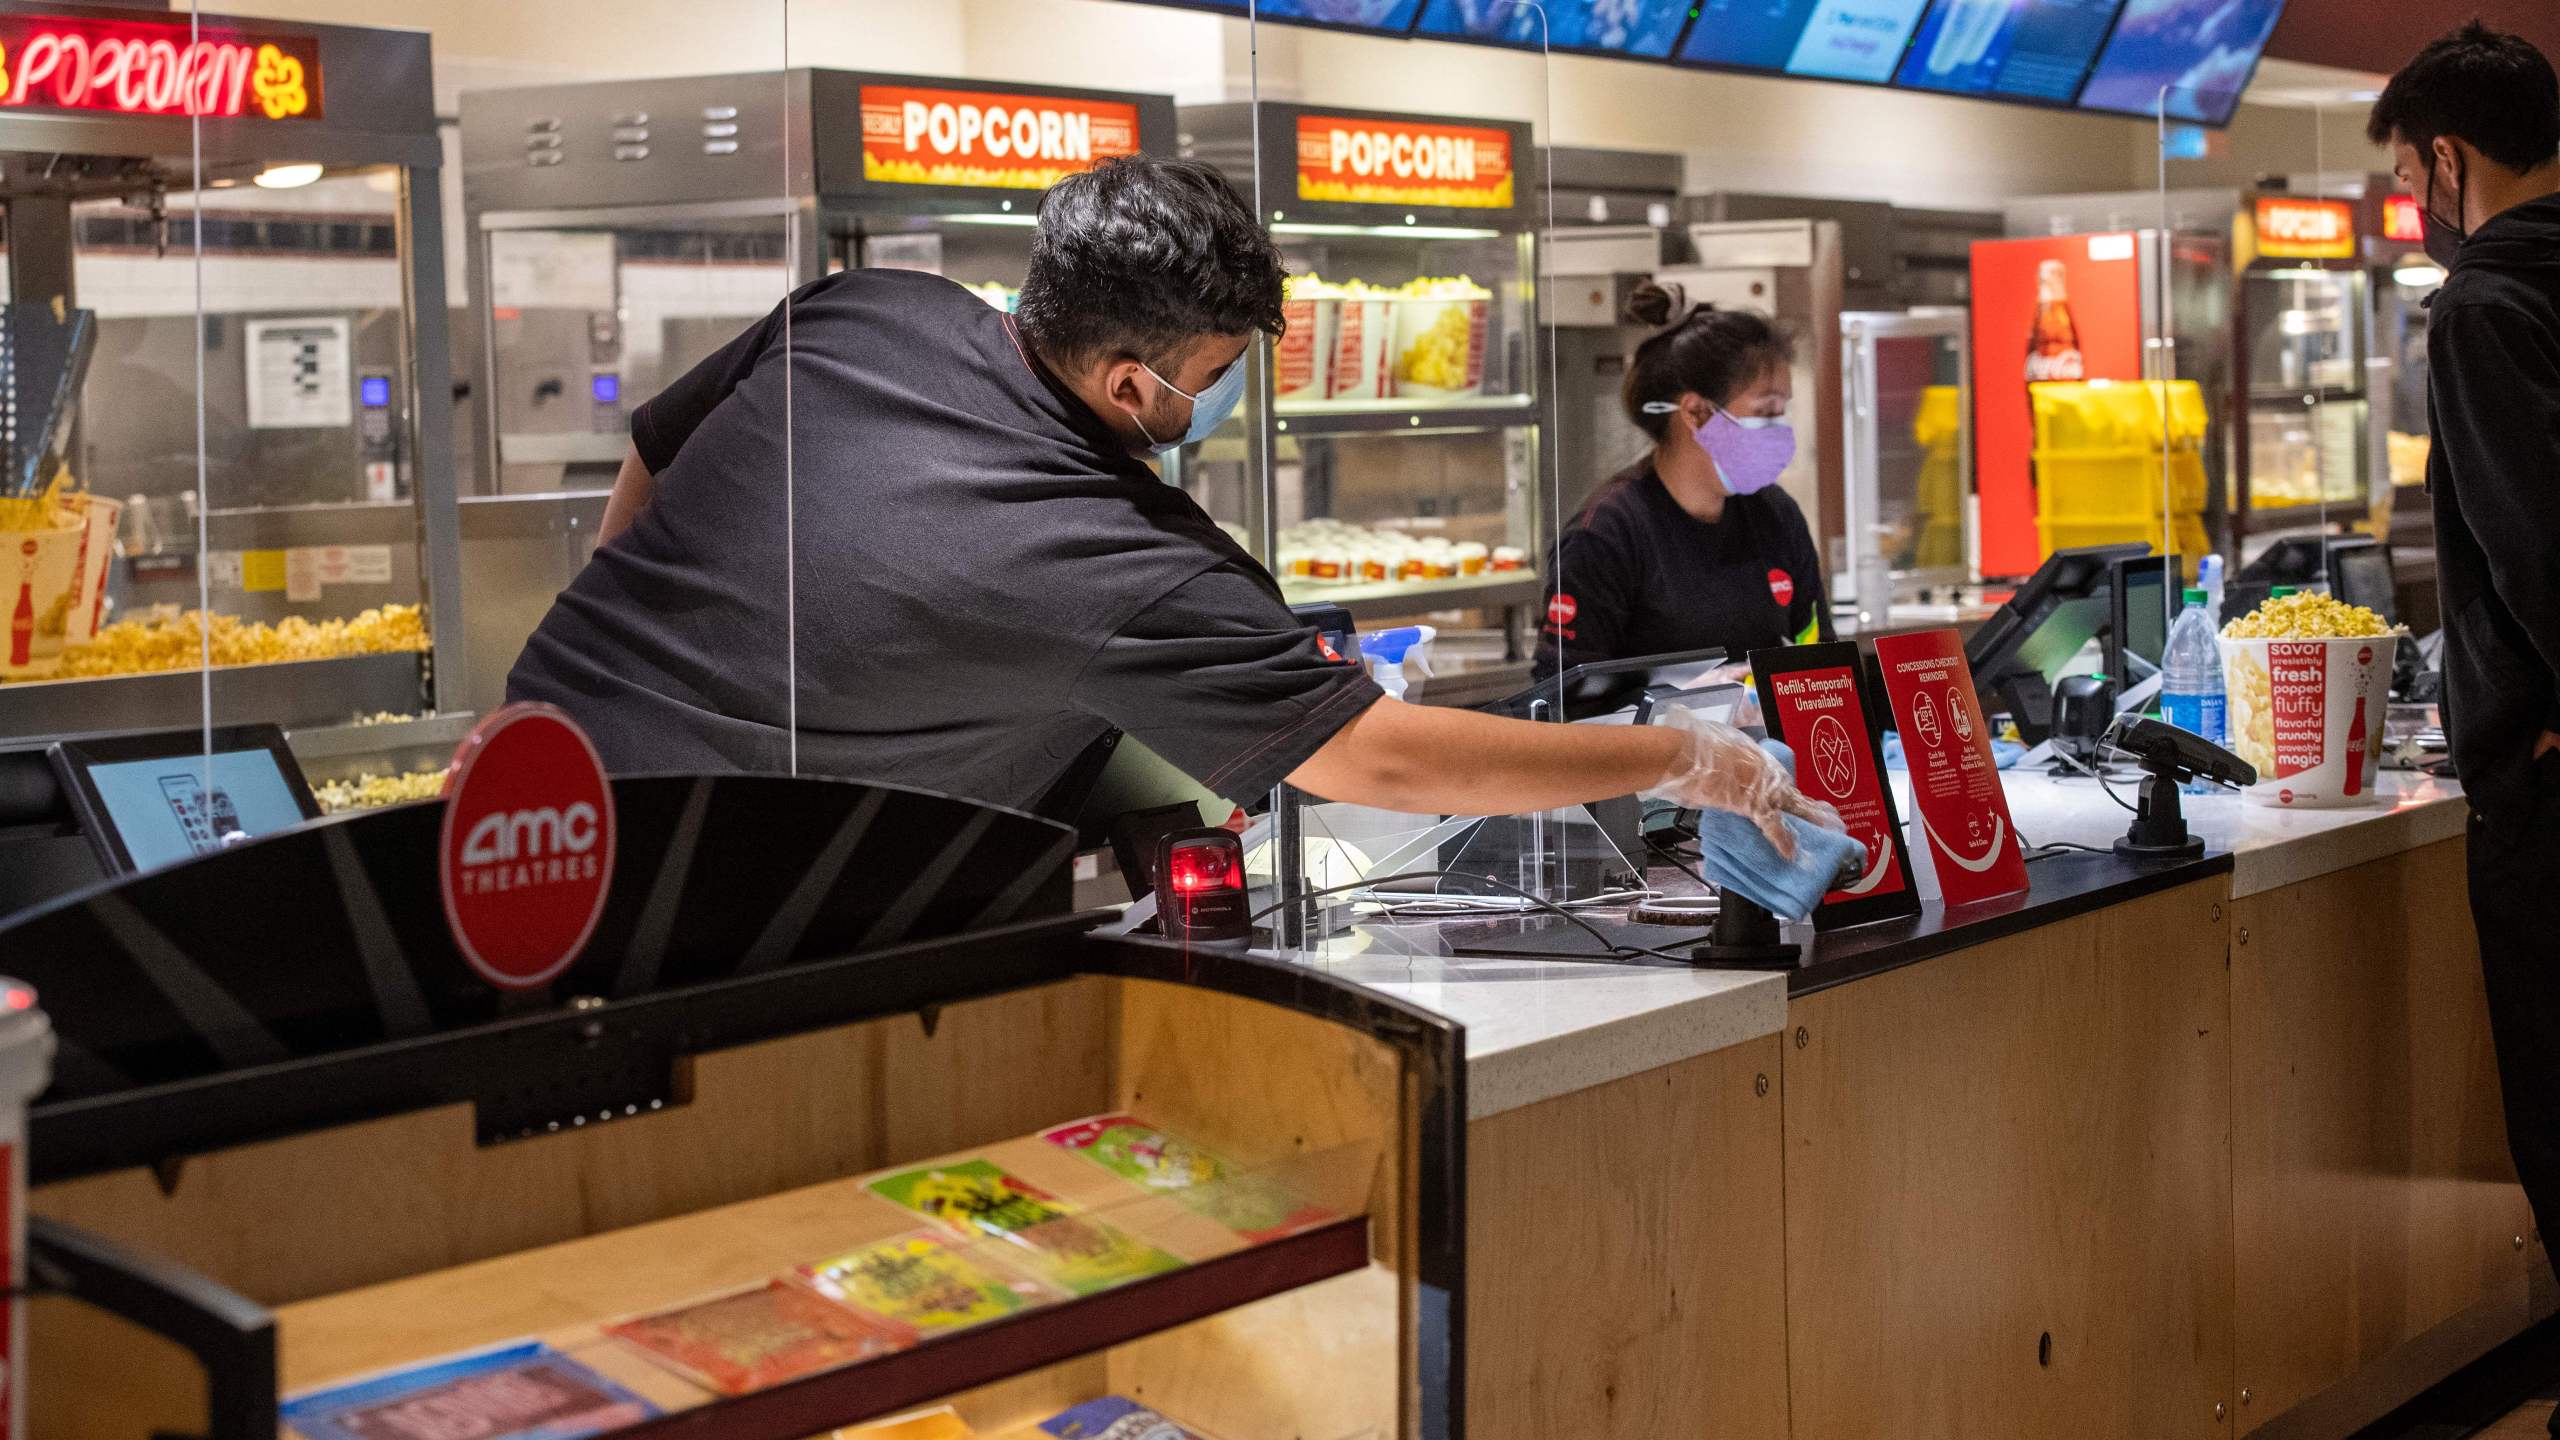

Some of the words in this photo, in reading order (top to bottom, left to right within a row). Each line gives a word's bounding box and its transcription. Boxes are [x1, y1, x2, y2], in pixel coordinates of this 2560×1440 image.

[12, 33, 252, 115] POPCORN
[903, 100, 1091, 161] POPCORN
[1329, 128, 1475, 181] POPCORN
[2271, 644, 2320, 655] savor
[1897, 660, 1935, 673] CONCESSIONS
[2272, 657, 2322, 666] irresistibly
[1918, 670, 1948, 682] REMINDERS
[2272, 666, 2322, 682] fresh
[1776, 680, 1805, 695] Refills
[1805, 674, 1853, 694] Temporarily
[2273, 683, 2322, 694] popped
[1795, 693, 1844, 711] Unavailable
[2275, 696, 2322, 716] fluffy
[2276, 718, 2322, 728] flavorful
[2276, 729, 2322, 742] crunchy
[2278, 752, 2321, 768] magic
[462, 854, 598, 896] THEATRES
